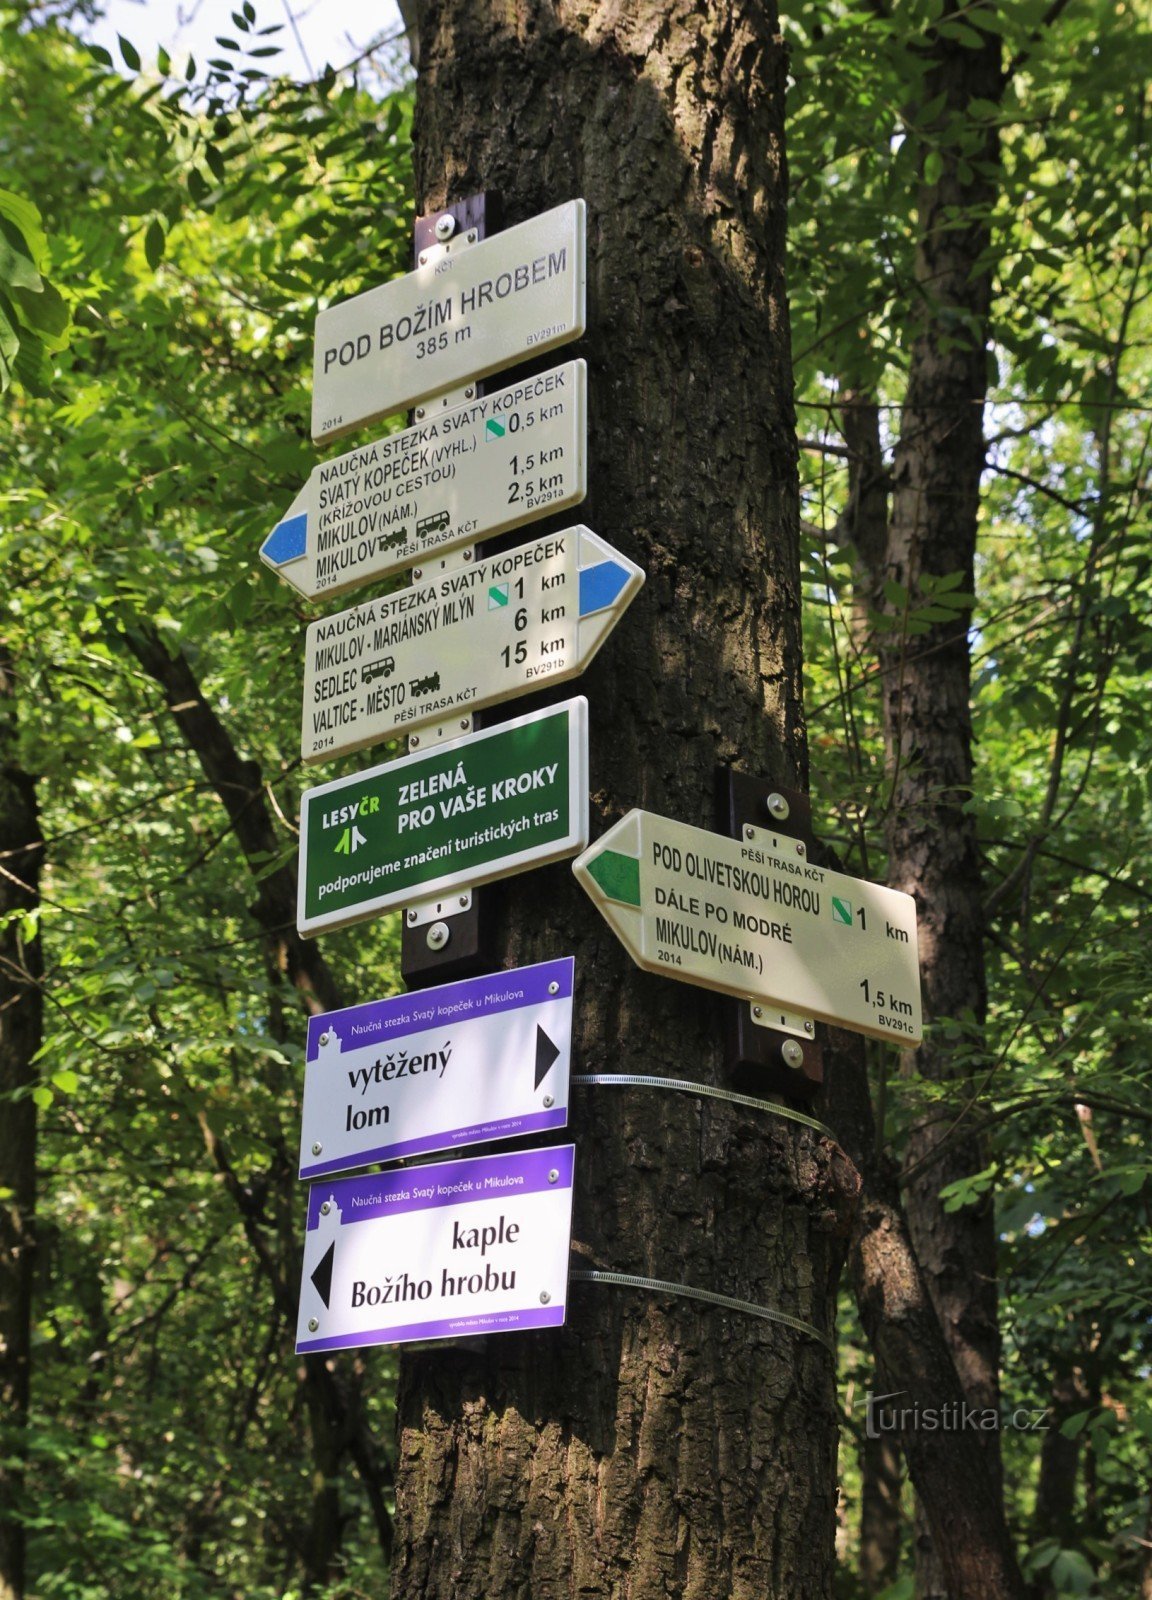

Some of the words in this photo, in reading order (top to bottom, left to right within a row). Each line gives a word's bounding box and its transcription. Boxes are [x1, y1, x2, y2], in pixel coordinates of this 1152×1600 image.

[324, 334, 371, 374] POD
[379, 297, 452, 350] BOŽÍM
[461, 247, 567, 315] HROBEM
[416, 332, 448, 360] 385
[454, 326, 471, 344] m
[526, 323, 566, 345] BV291m
[320, 446, 377, 485] NAUČNÁ
[383, 425, 438, 459] STEZKA
[442, 402, 489, 434] SVATÝ
[492, 372, 565, 417] KOPEČEK
[322, 415, 343, 432] 2014
[508, 411, 535, 433] 0,5
[539, 402, 563, 422] km
[509, 455, 535, 477] 1,5
[539, 445, 563, 465] km
[318, 487, 391, 531] (KŘÍŽOVOU
[395, 463, 456, 499] CESTOU)
[319, 472, 359, 509] SVATÝ
[508, 481, 535, 504] 2,5
[539, 472, 563, 492] km
[527, 489, 564, 509] BV291a
[396, 540, 419, 559] PĚŠÍ
[421, 530, 455, 553] TRASA
[457, 519, 479, 540] KČT
[316, 537, 378, 579] MIKULOV
[316, 575, 337, 590] 2014
[317, 610, 376, 643] NAUČNÁ
[380, 587, 437, 620] STEZKA
[441, 564, 487, 596] SVATÝ
[491, 539, 566, 579] KOPEČEK
[515, 578, 524, 600] 1
[541, 572, 566, 591] km
[315, 635, 364, 673] MIKULOV
[373, 602, 440, 651] MARIÁNSKÝ
[442, 592, 475, 627] MLÝN
[515, 608, 528, 632] 6
[541, 605, 566, 624] km
[501, 639, 527, 668] 15
[540, 637, 566, 656] km
[525, 658, 565, 678] BV291b
[314, 669, 357, 704] SEDLEC
[313, 700, 357, 734] VALTICE
[366, 682, 405, 717] MĚSTO
[393, 706, 417, 724] PĚŠÍ
[420, 695, 454, 718] TRASA
[456, 687, 478, 705] KČT
[312, 736, 335, 751] 2014
[398, 761, 467, 806] ZELENÁ
[398, 806, 435, 834] PRO
[440, 787, 486, 820] VAŠE
[492, 763, 559, 803] KROKY
[318, 853, 401, 900] podporujeme
[404, 840, 452, 869] značení
[454, 816, 530, 852] turistických
[534, 808, 559, 827] tras
[741, 848, 765, 864] PĚŠÍ
[767, 856, 802, 876] TRASA
[804, 867, 825, 883] KČT
[653, 842, 682, 873] POD
[685, 854, 770, 900] OLIVETSKOU
[773, 879, 820, 916] HOROU
[655, 886, 700, 916] DÁLE
[705, 902, 728, 923] PO
[733, 913, 792, 944] MODRÉ
[856, 907, 867, 931] 1
[886, 922, 909, 943] km
[658, 950, 682, 966] 2014
[351, 1019, 382, 1036] Naučná
[384, 1014, 411, 1028] stezka
[413, 1007, 435, 1021] Svatý
[437, 999, 473, 1017] kopeček
[484, 989, 524, 1005] Mikulova
[860, 978, 885, 1008] 1,5
[890, 995, 913, 1016] km
[878, 1014, 914, 1034] BV291c
[348, 1040, 452, 1095] vytěžený
[346, 1104, 390, 1132] lom
[351, 1193, 382, 1208] Naučná
[384, 1190, 410, 1203] stezka
[412, 1185, 435, 1199] Svatý
[437, 1180, 473, 1197] kopeček
[484, 1175, 524, 1189] Mikulova
[452, 1215, 520, 1256] kaple
[351, 1266, 432, 1308] Božího
[440, 1263, 516, 1297] hrobu
